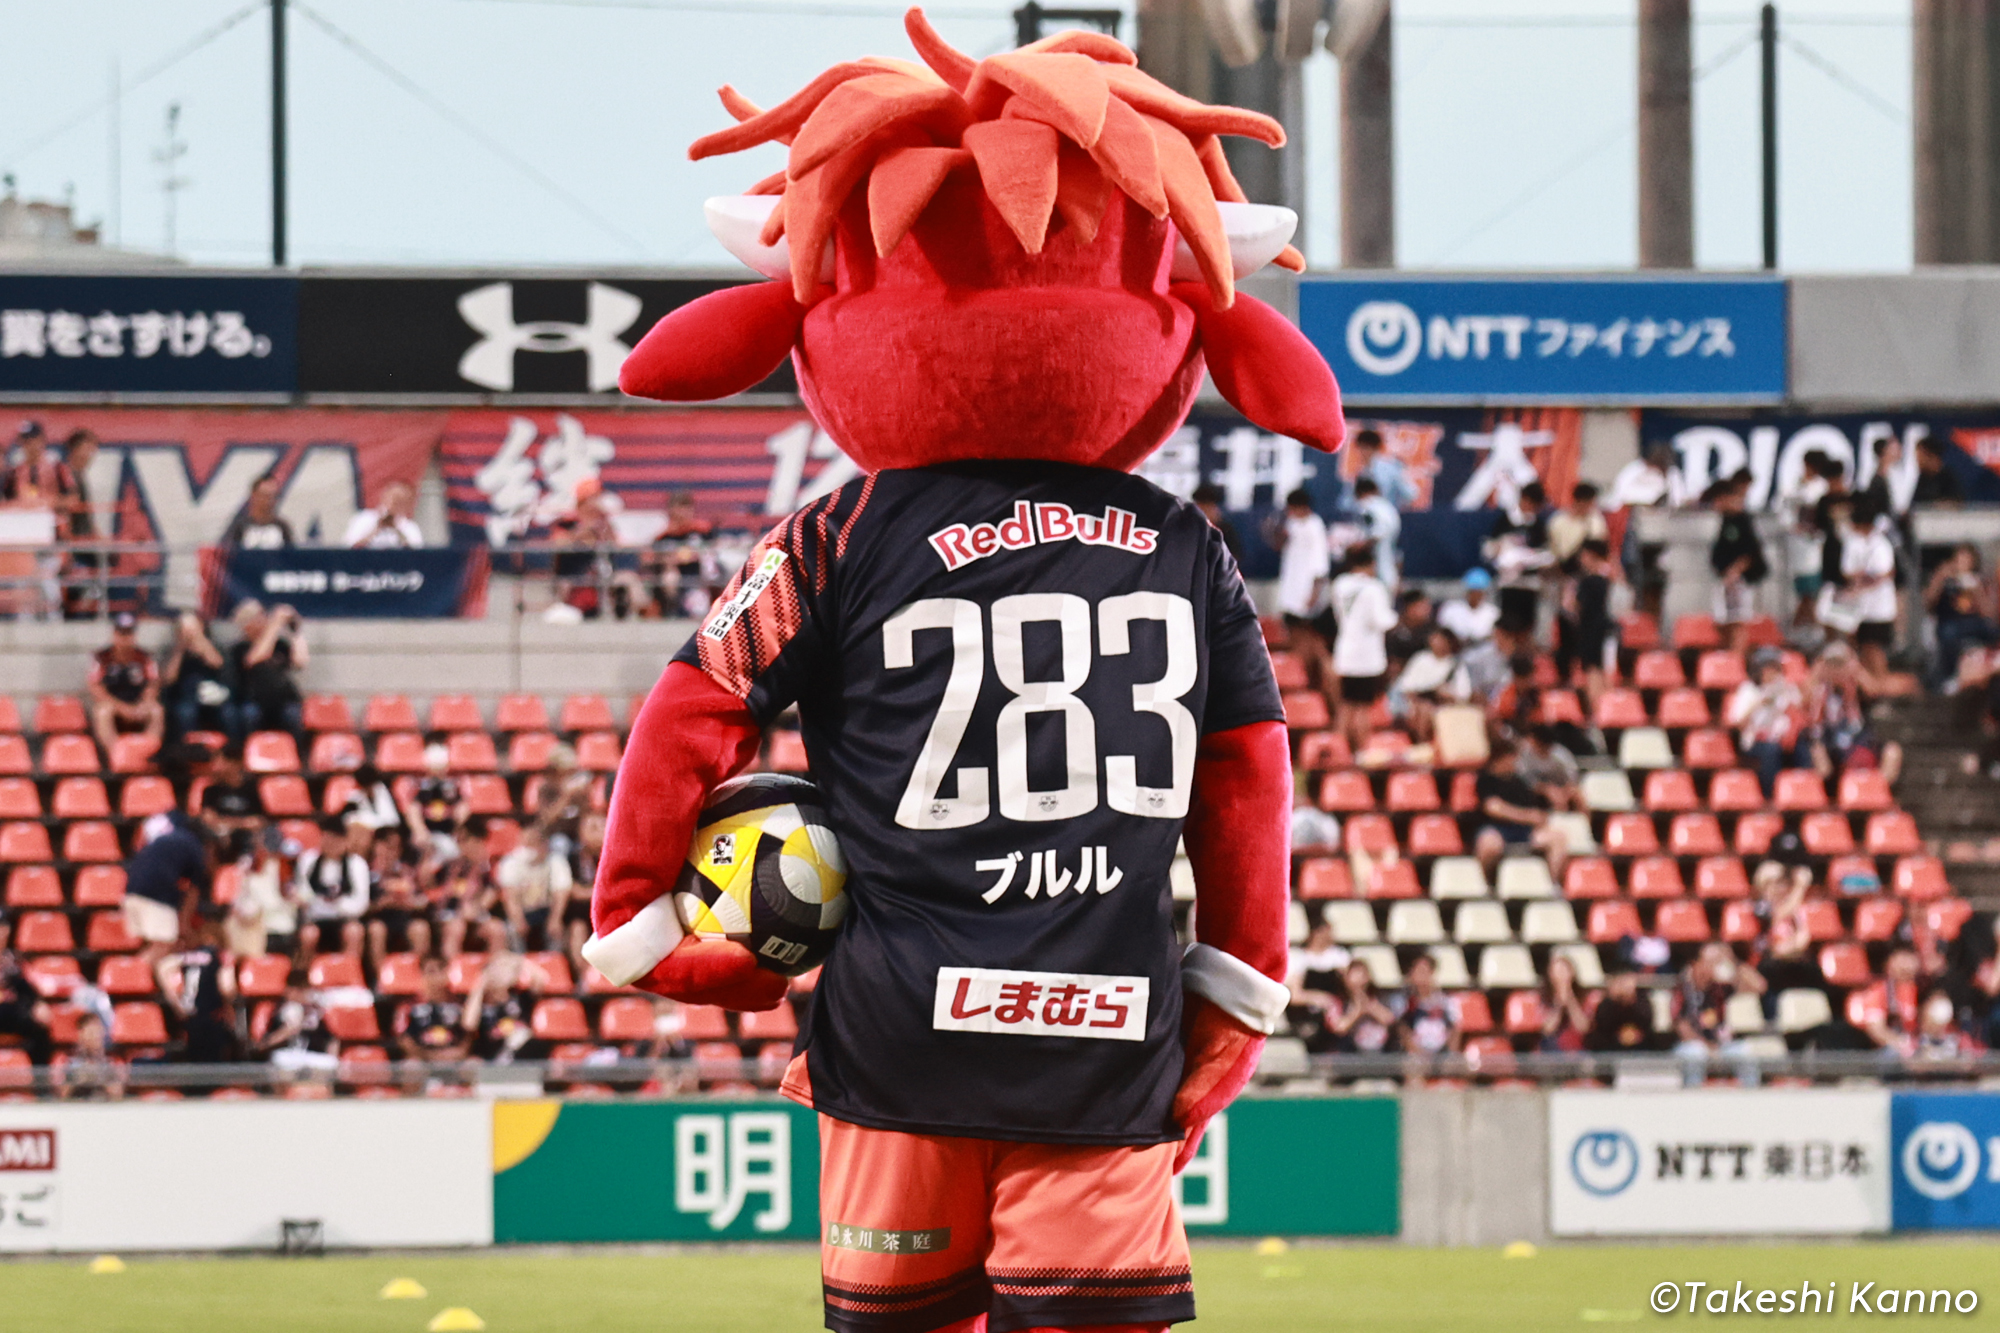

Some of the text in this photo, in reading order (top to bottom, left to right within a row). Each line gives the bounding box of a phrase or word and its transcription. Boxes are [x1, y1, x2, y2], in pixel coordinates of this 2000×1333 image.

[928, 500, 1160, 572] Red Bulls
[882, 591, 1198, 830] 283
[975, 846, 1124, 905] ブルル
[950, 977, 1134, 1029] しまむら
[0, 1134, 51, 1167] MI
[843, 1227, 931, 1251] 氷川茶庭
